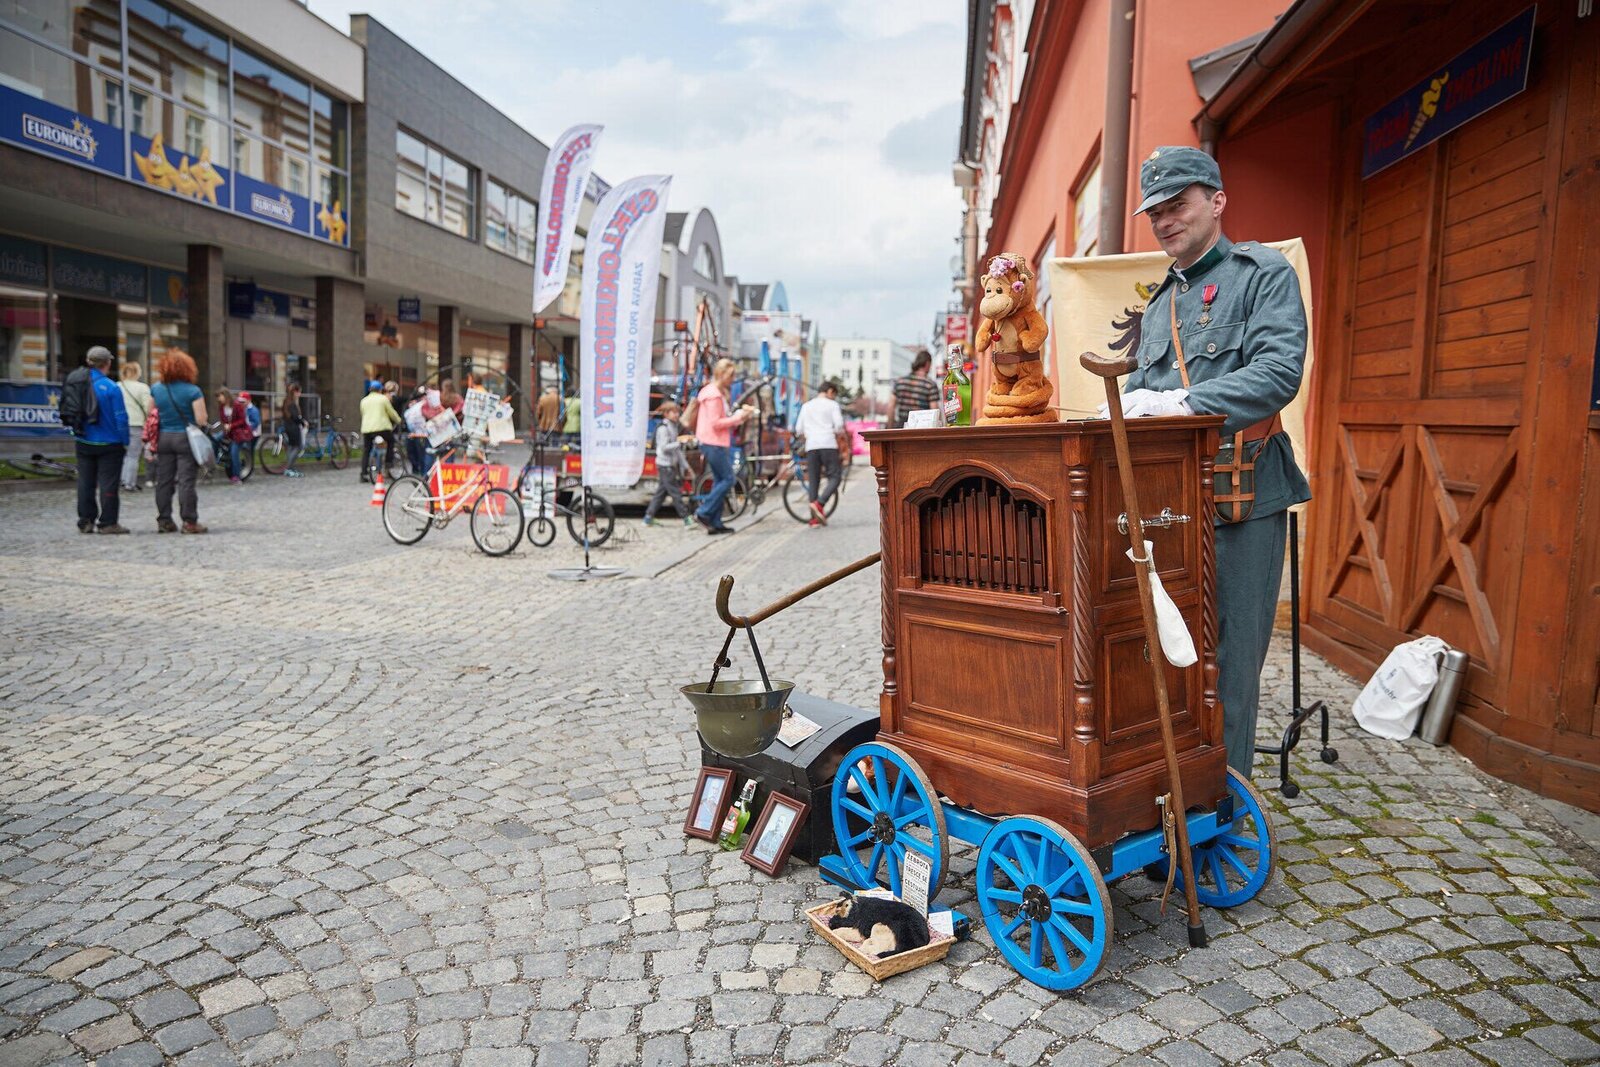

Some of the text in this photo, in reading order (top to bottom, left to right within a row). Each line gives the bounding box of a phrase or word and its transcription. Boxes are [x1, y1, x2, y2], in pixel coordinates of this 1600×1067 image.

[27, 119, 89, 153] EURONICS
[254, 198, 290, 219] EURONICS
[0, 408, 63, 424] EURONIC
